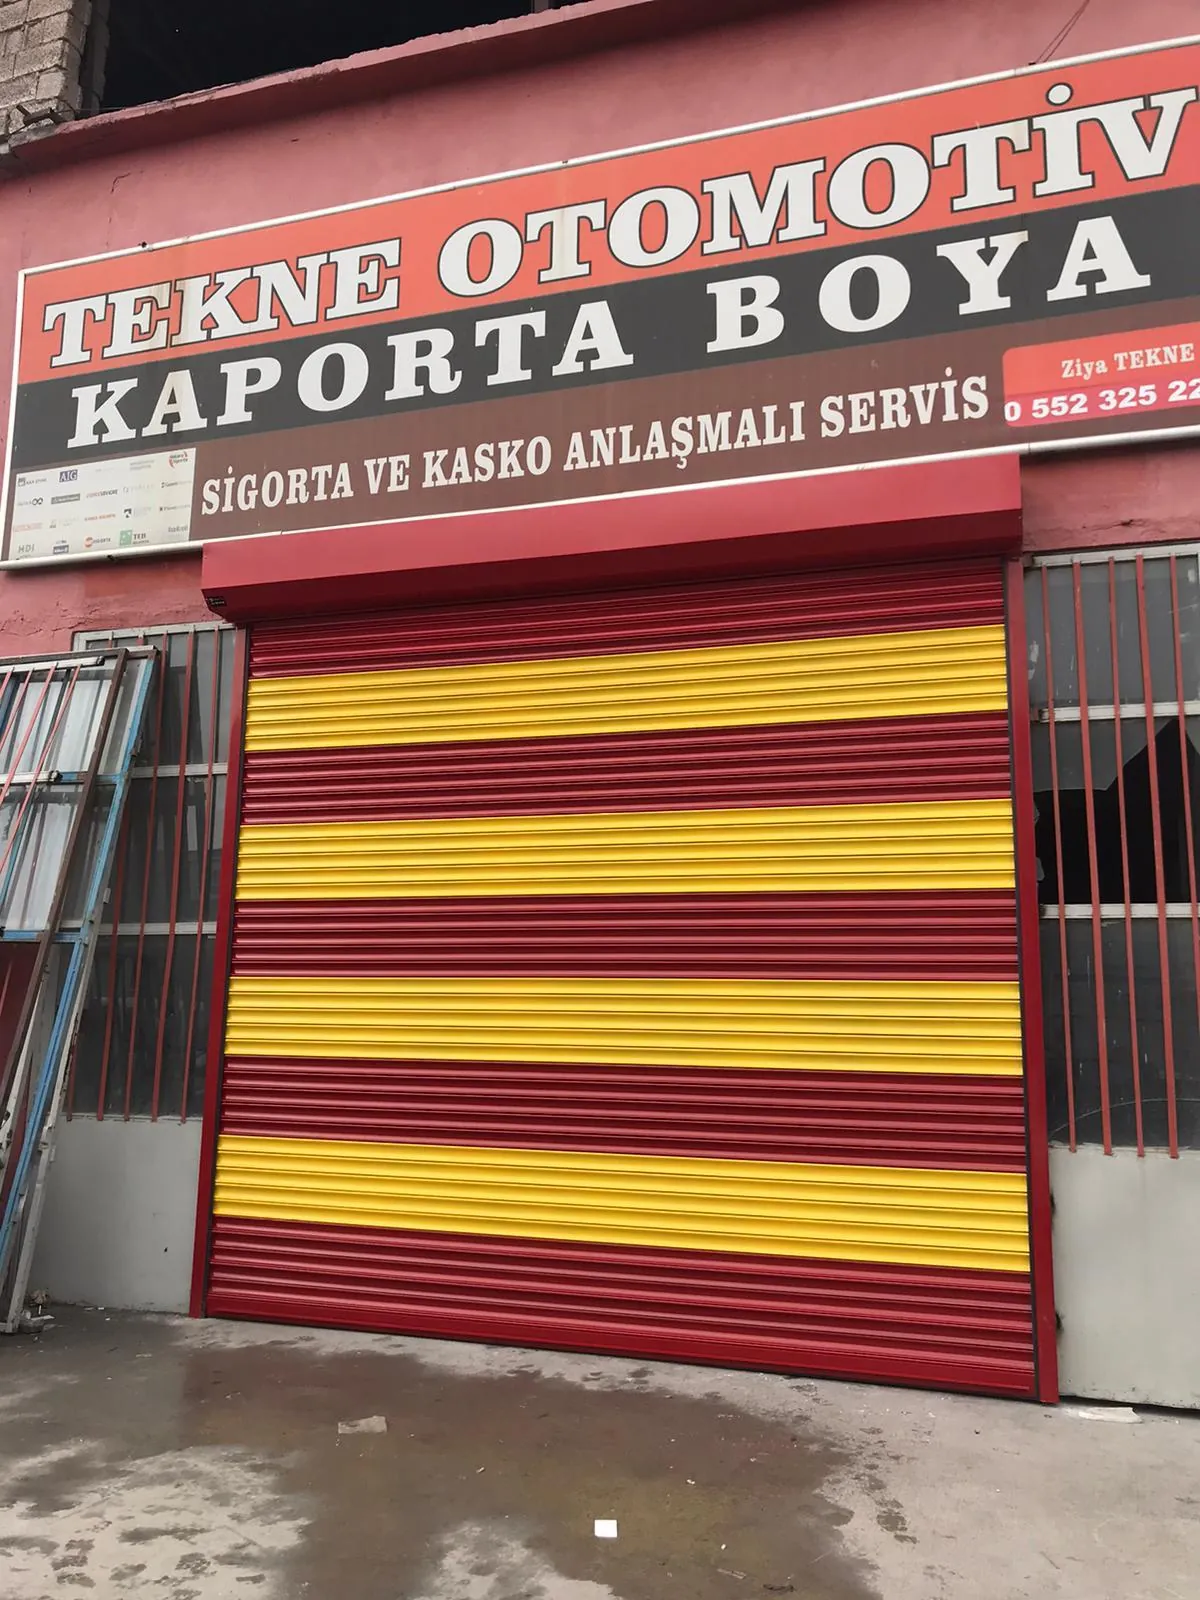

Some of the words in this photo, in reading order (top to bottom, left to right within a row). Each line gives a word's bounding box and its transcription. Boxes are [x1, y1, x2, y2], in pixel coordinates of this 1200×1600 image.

[42, 237, 402, 368] TEKNE
[437, 83, 1198, 297] OTOMOTİV
[67, 299, 634, 449] KAPORTA
[706, 215, 1151, 354] BOYA
[1061, 358, 1108, 380] Ziya
[1114, 343, 1195, 371] TEKNE
[201, 462, 353, 516] SİGORTA
[364, 454, 410, 492] VE
[422, 435, 551, 489] KASKO
[563, 401, 805, 471] ANLAŞMALI
[820, 366, 989, 438] SERVİS
[1003, 401, 1021, 422] 0
[1031, 393, 1088, 419] 552
[1098, 384, 1157, 411] 325
[59, 470, 78, 482] AIG
